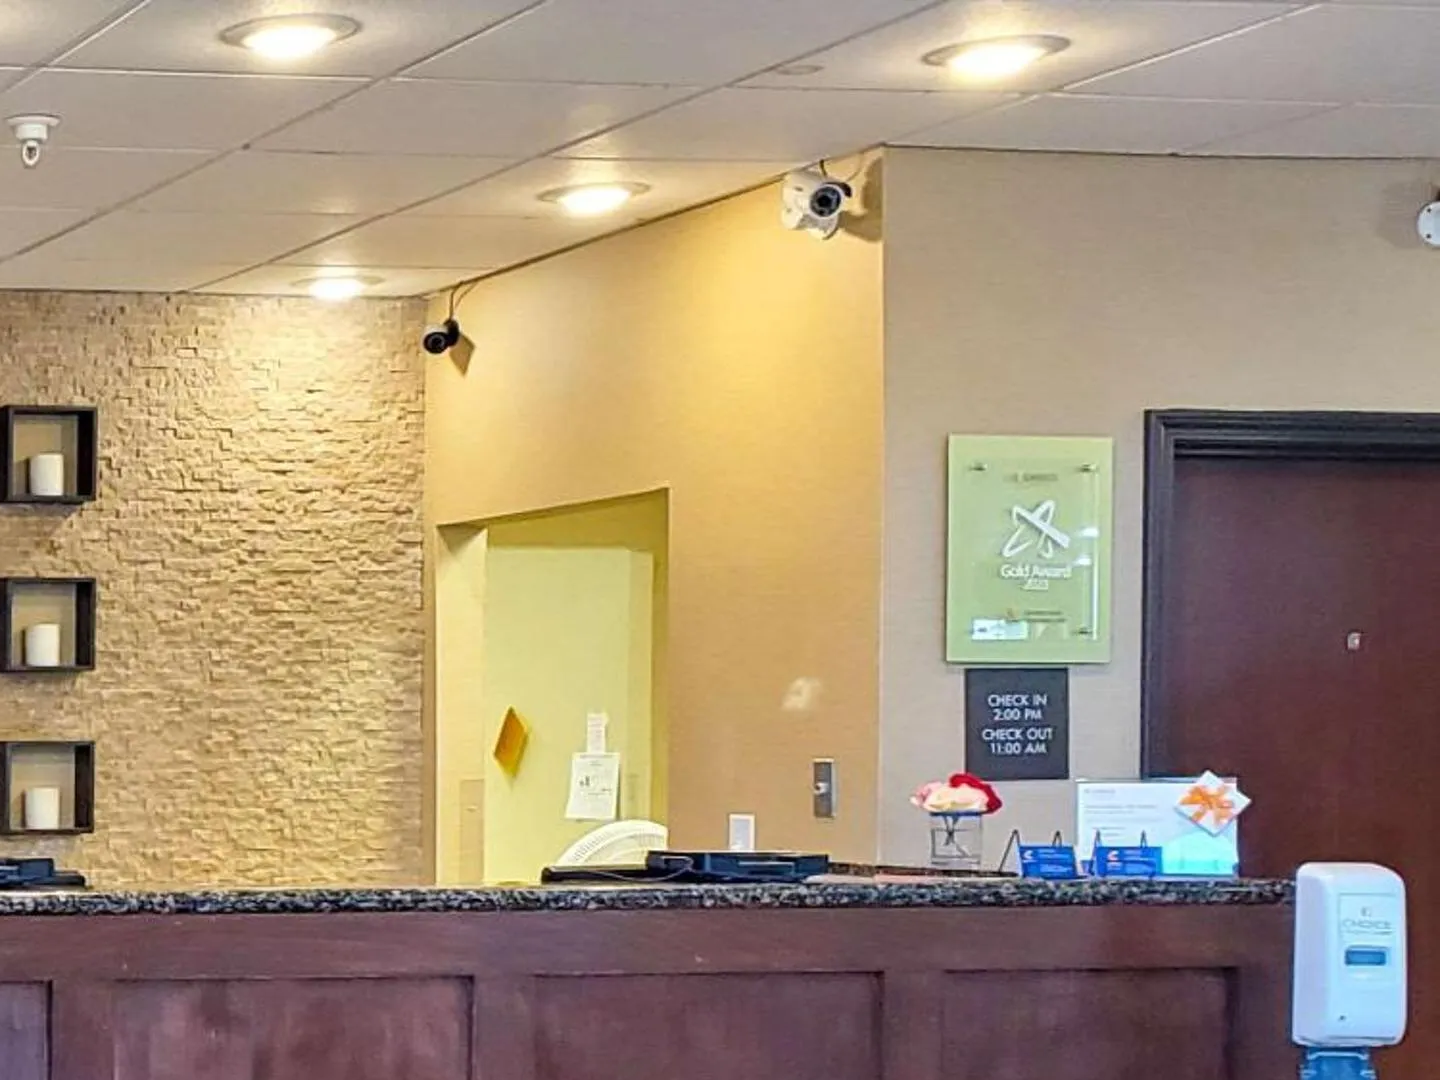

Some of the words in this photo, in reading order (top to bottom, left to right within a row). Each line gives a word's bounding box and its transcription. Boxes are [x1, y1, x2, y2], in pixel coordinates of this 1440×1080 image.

[1001, 563, 1029, 578] Gold
[1032, 565, 1072, 579] Award
[987, 694, 1029, 707] CHECK
[1032, 694, 1048, 706] IN
[993, 708, 1020, 721] 2:00
[1024, 708, 1042, 720] PM
[982, 728, 1023, 741] CHECK
[1026, 727, 1053, 740] OUT
[990, 742, 1021, 754] 11:00
[1024, 742, 1047, 754] AM
